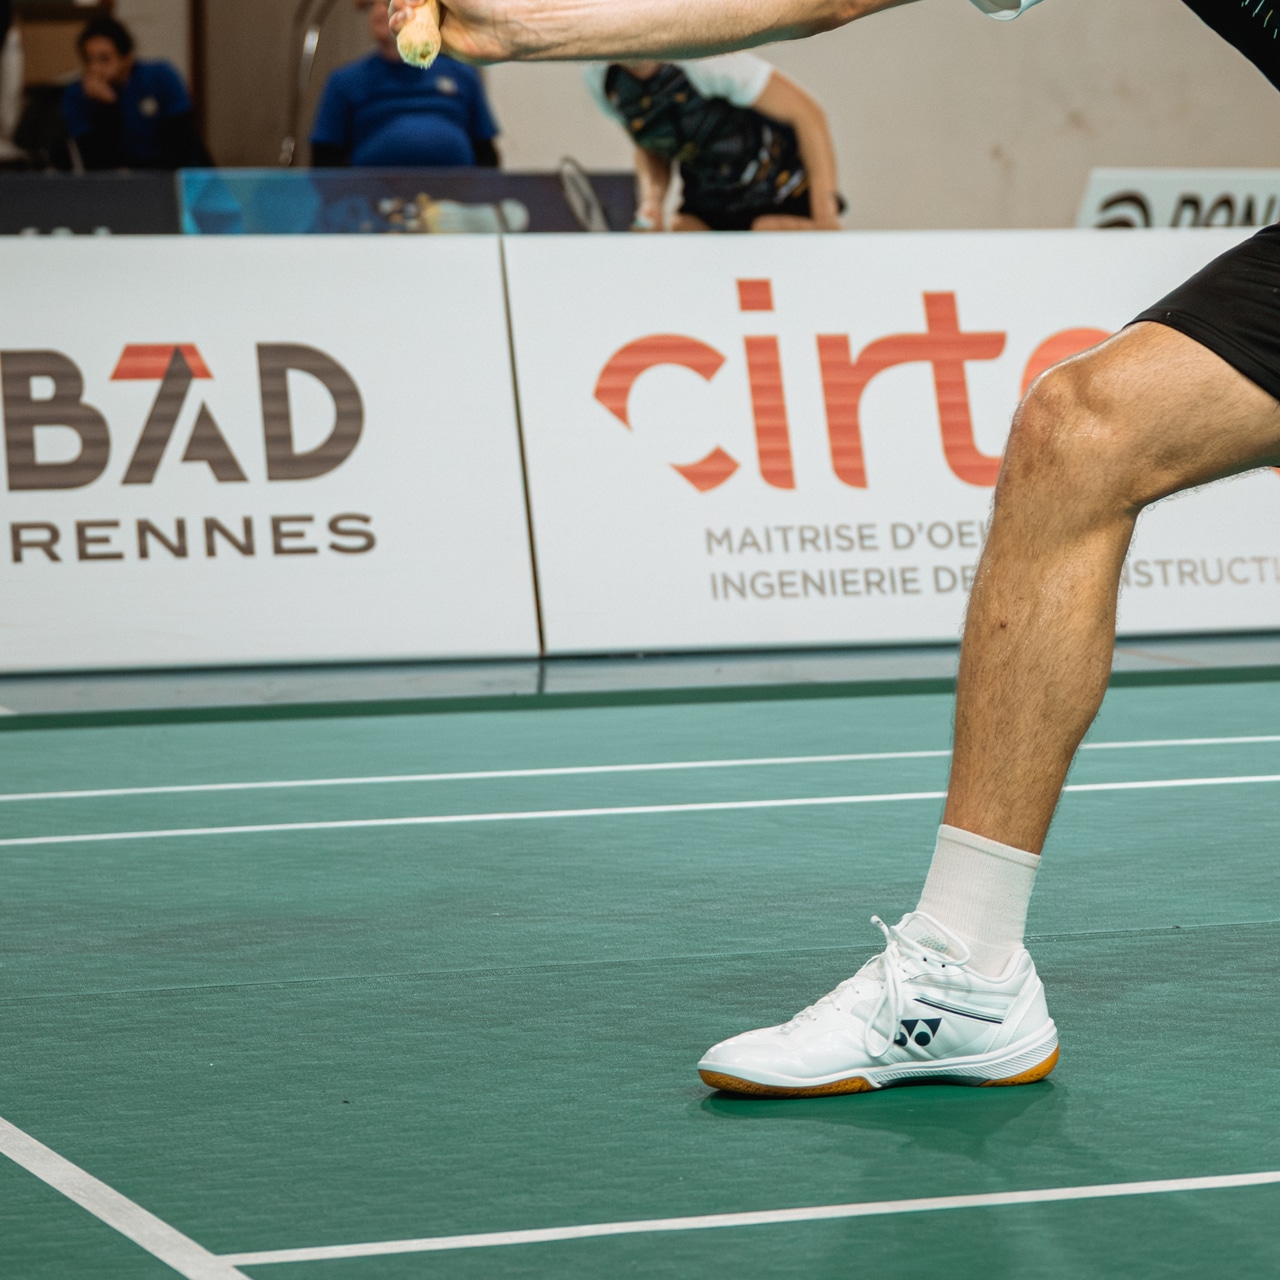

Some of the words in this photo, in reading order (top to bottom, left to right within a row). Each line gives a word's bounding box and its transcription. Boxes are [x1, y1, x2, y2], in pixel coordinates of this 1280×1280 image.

[10, 512, 377, 563] RENNES
[705, 523, 879, 554] MAITRISE
[890, 520, 990, 551] D'OE
[710, 567, 921, 600] INGENIERIE
